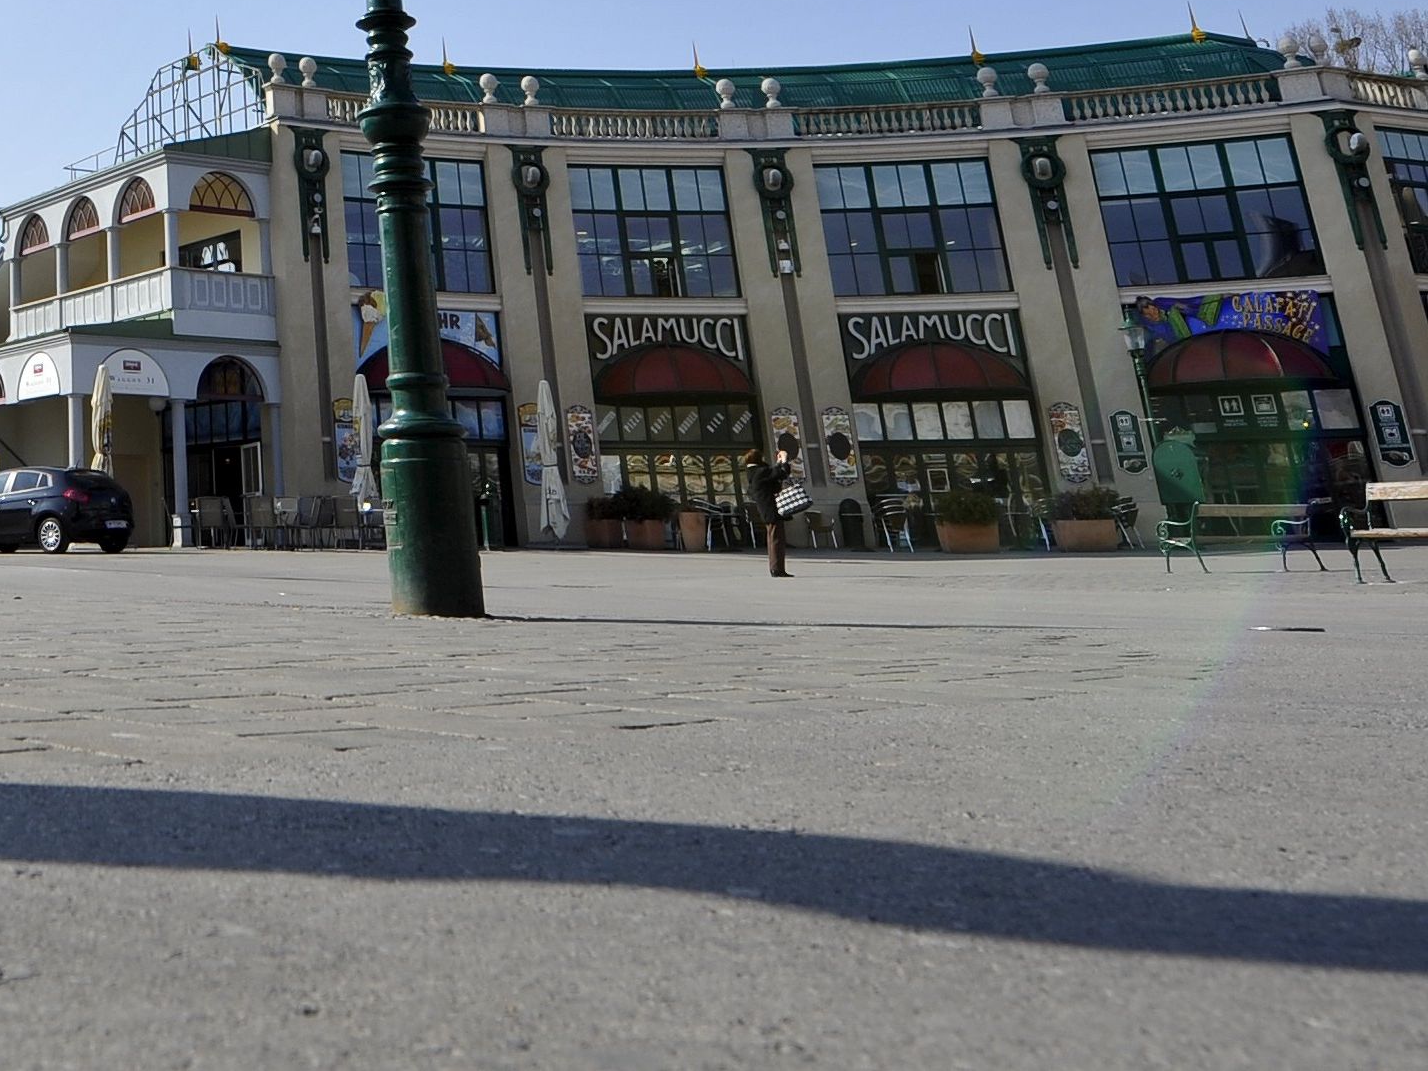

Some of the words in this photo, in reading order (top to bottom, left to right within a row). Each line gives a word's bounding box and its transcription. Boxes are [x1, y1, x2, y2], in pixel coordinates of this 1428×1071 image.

[593, 317, 744, 360] SALAMUCCI
[847, 313, 1016, 360] SALAMUCCI
[1243, 312, 1313, 342] PASSAGE
